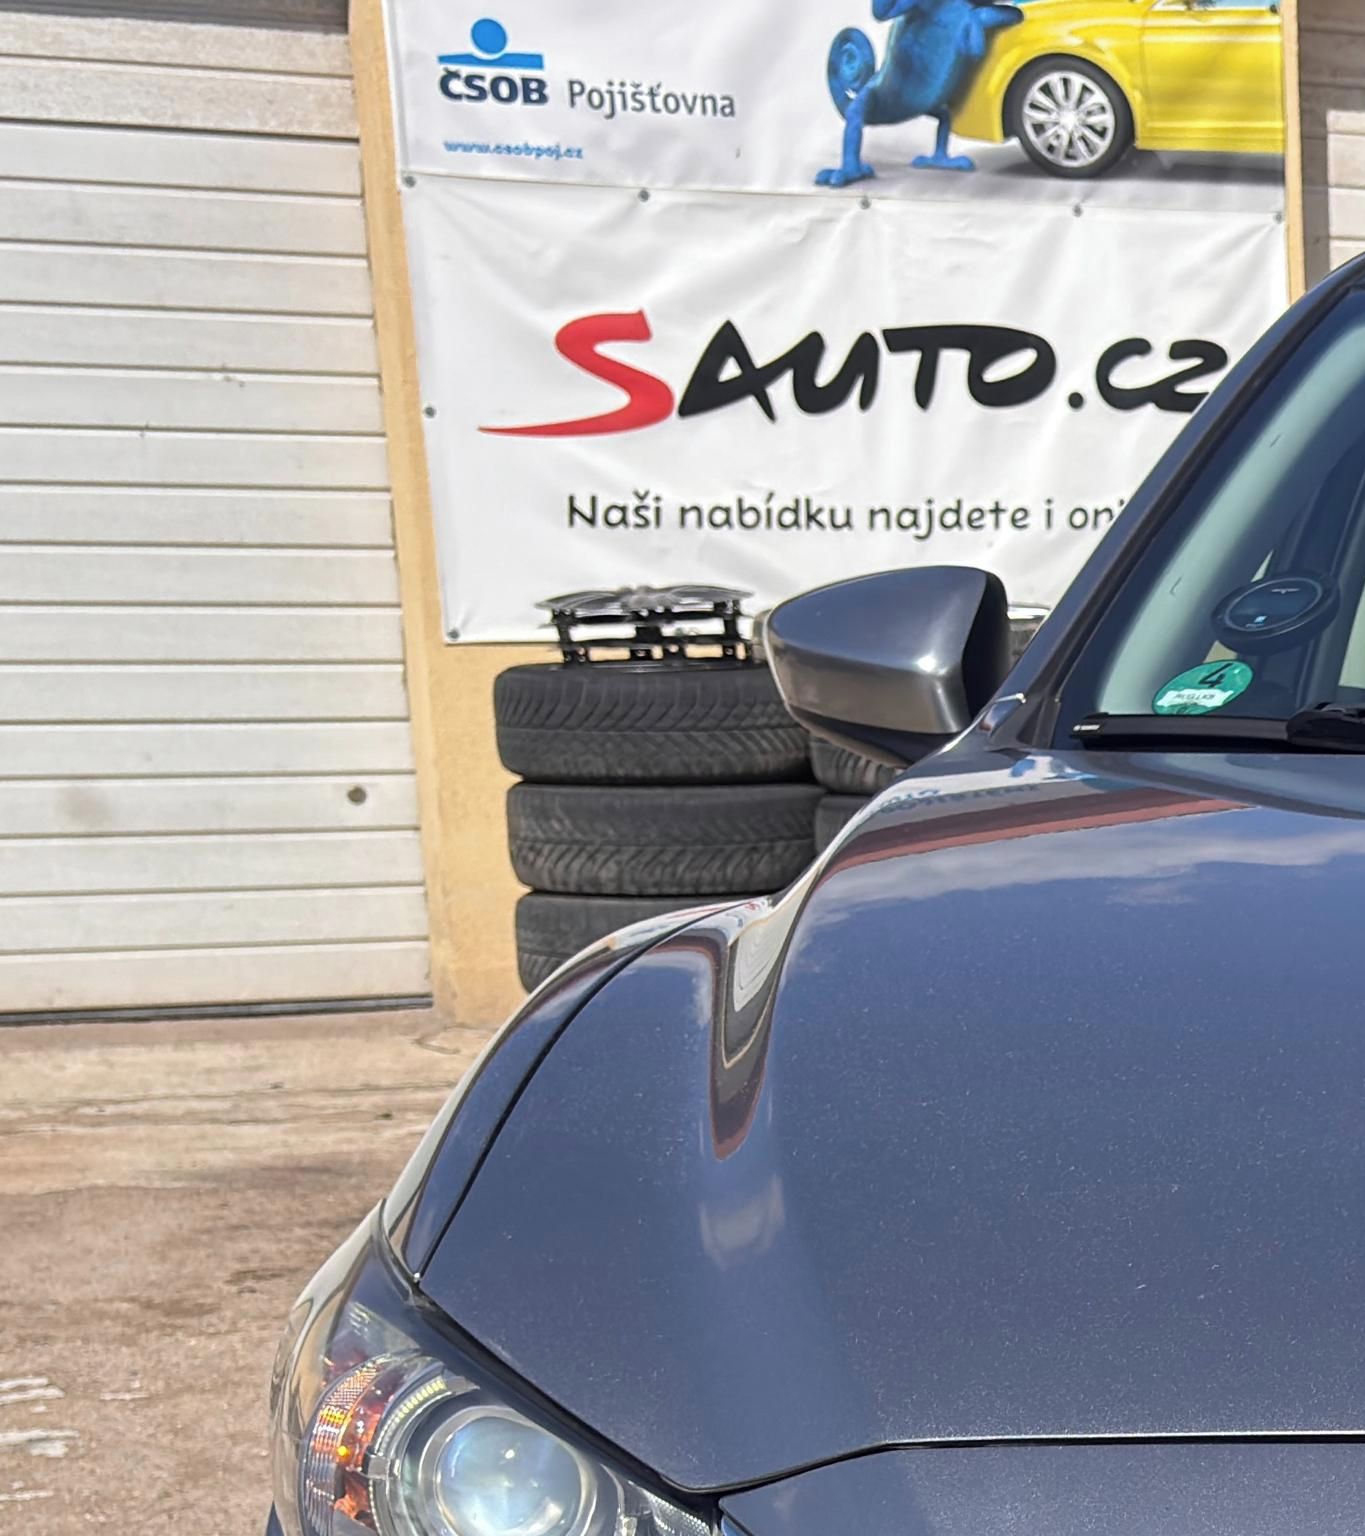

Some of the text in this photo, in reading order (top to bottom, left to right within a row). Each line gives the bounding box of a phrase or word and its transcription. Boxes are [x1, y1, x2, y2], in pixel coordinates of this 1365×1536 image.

[438, 69, 736, 119] ČSOB Pojišťovna
[444, 140, 582, 159] www.csobpoj.cz
[567, 492, 1124, 540] Naši nabídku najdete i on
